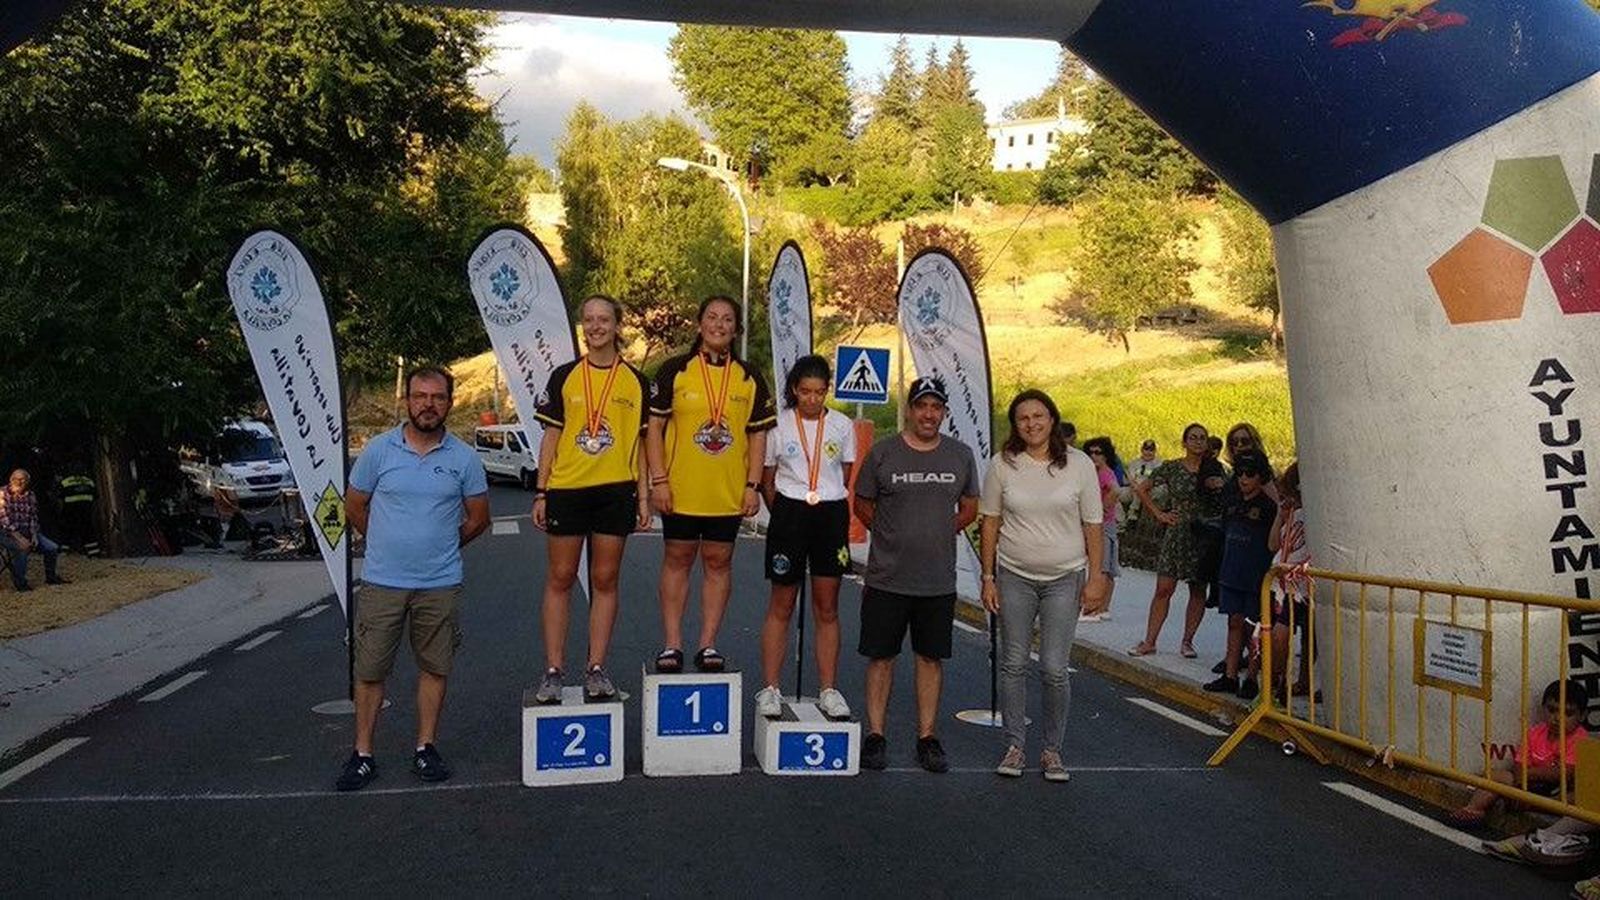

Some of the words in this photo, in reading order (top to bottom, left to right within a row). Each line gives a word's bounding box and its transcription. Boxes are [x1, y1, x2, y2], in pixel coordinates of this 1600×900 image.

[892, 472, 956, 484] HEAD
[684, 690, 701, 724] 1
[563, 722, 586, 757] 2
[803, 733, 826, 766] 3
